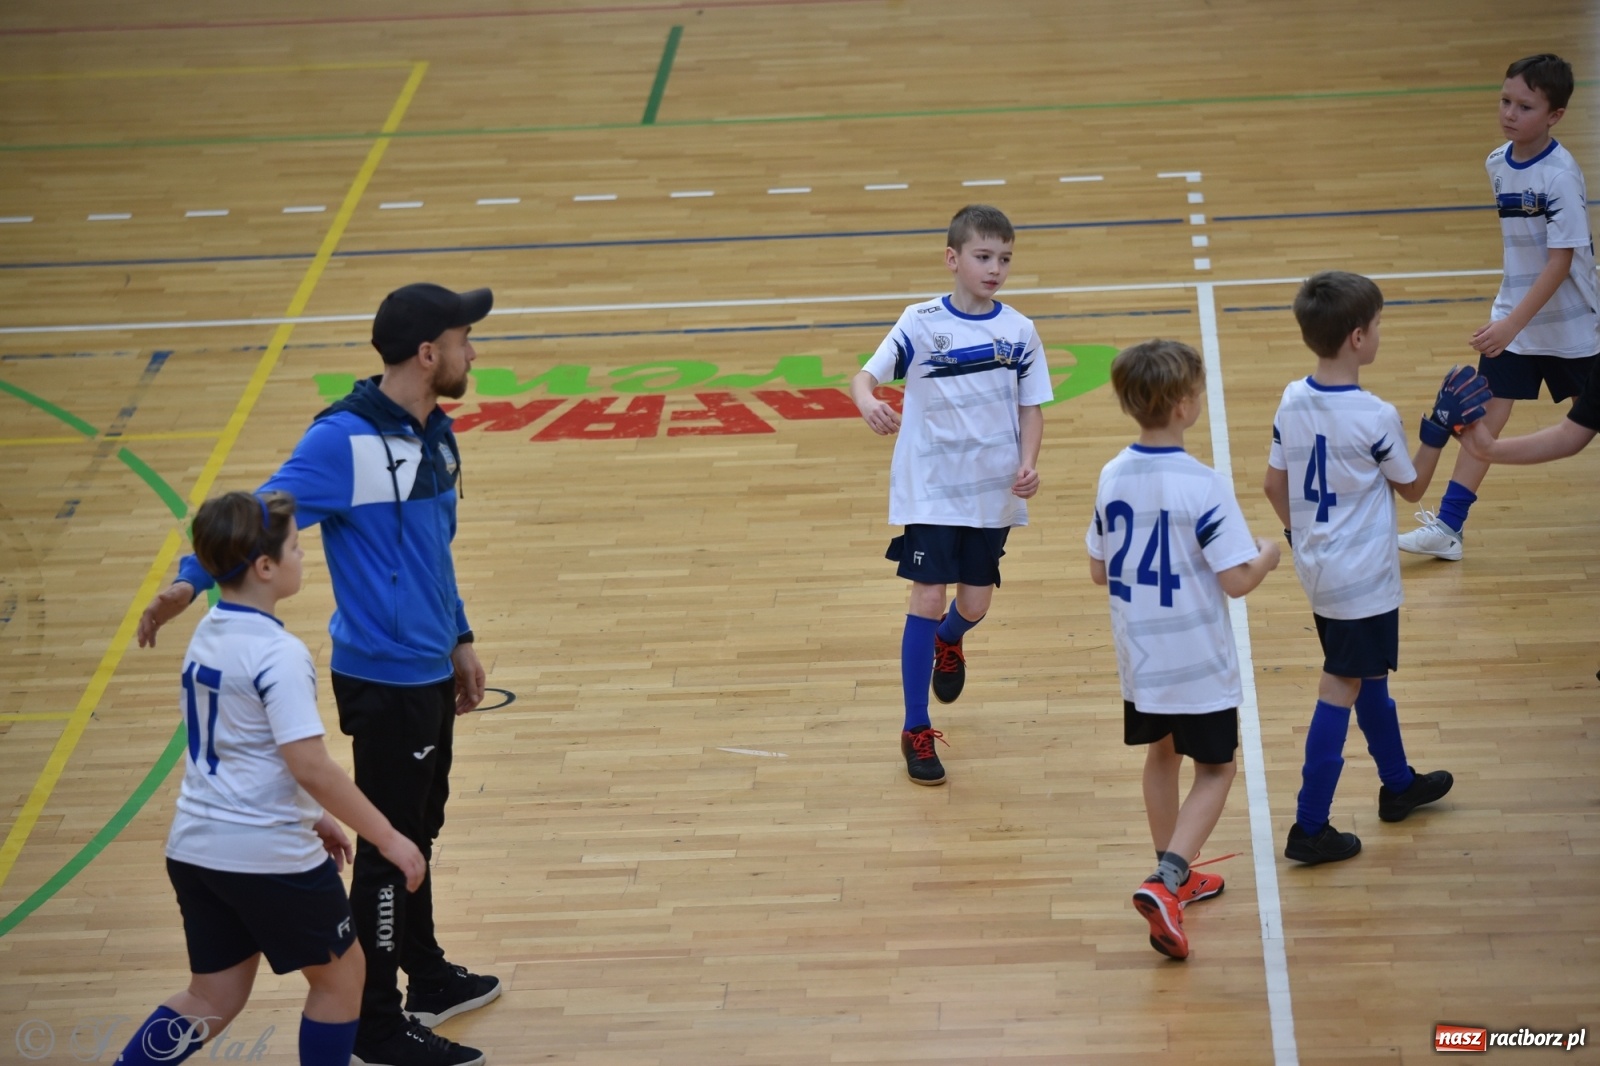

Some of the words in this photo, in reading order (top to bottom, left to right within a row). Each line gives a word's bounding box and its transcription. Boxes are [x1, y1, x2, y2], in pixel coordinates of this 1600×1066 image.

[1303, 433, 1337, 523] 4
[1105, 500, 1181, 608] 24
[182, 661, 222, 776] 17
